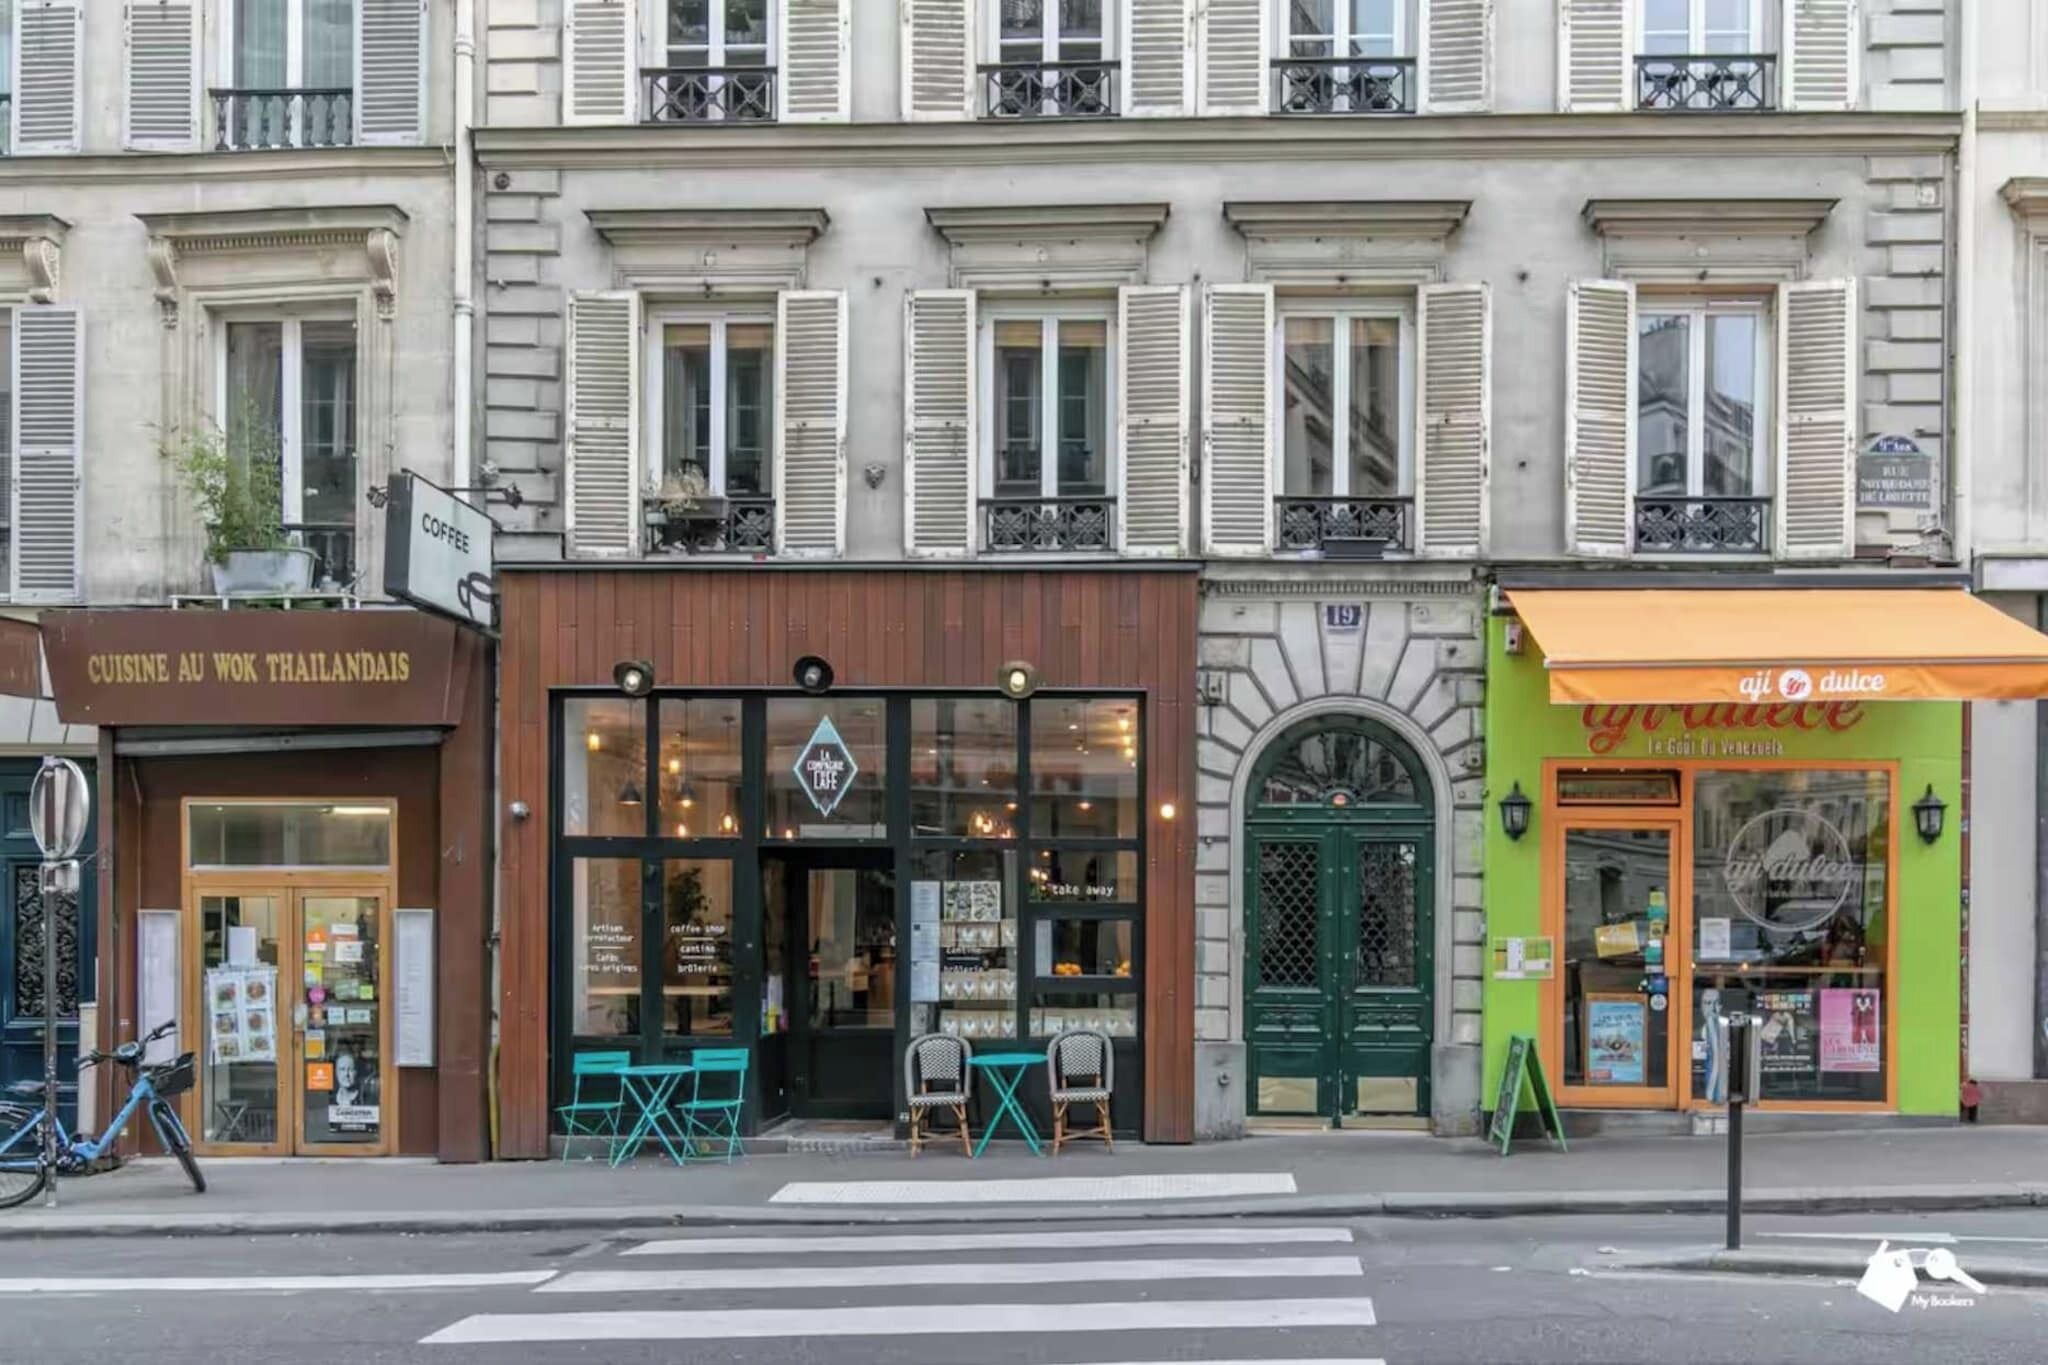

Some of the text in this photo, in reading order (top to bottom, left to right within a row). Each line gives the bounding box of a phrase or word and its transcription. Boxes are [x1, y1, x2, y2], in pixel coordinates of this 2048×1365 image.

[1882, 466, 1909, 477] RUE
[422, 513, 469, 554] COFFEE
[1333, 607, 1354, 625] 19
[88, 651, 410, 684] CUISINE AU WOK THAILANDAIS
[1819, 669, 1886, 693] dulce
[1648, 736, 1663, 755] Le
[1721, 737, 1784, 756] Venezuela
[1052, 884, 1115, 897] take away
[592, 922, 625, 932] Artisan
[670, 923, 701, 934] coffee
